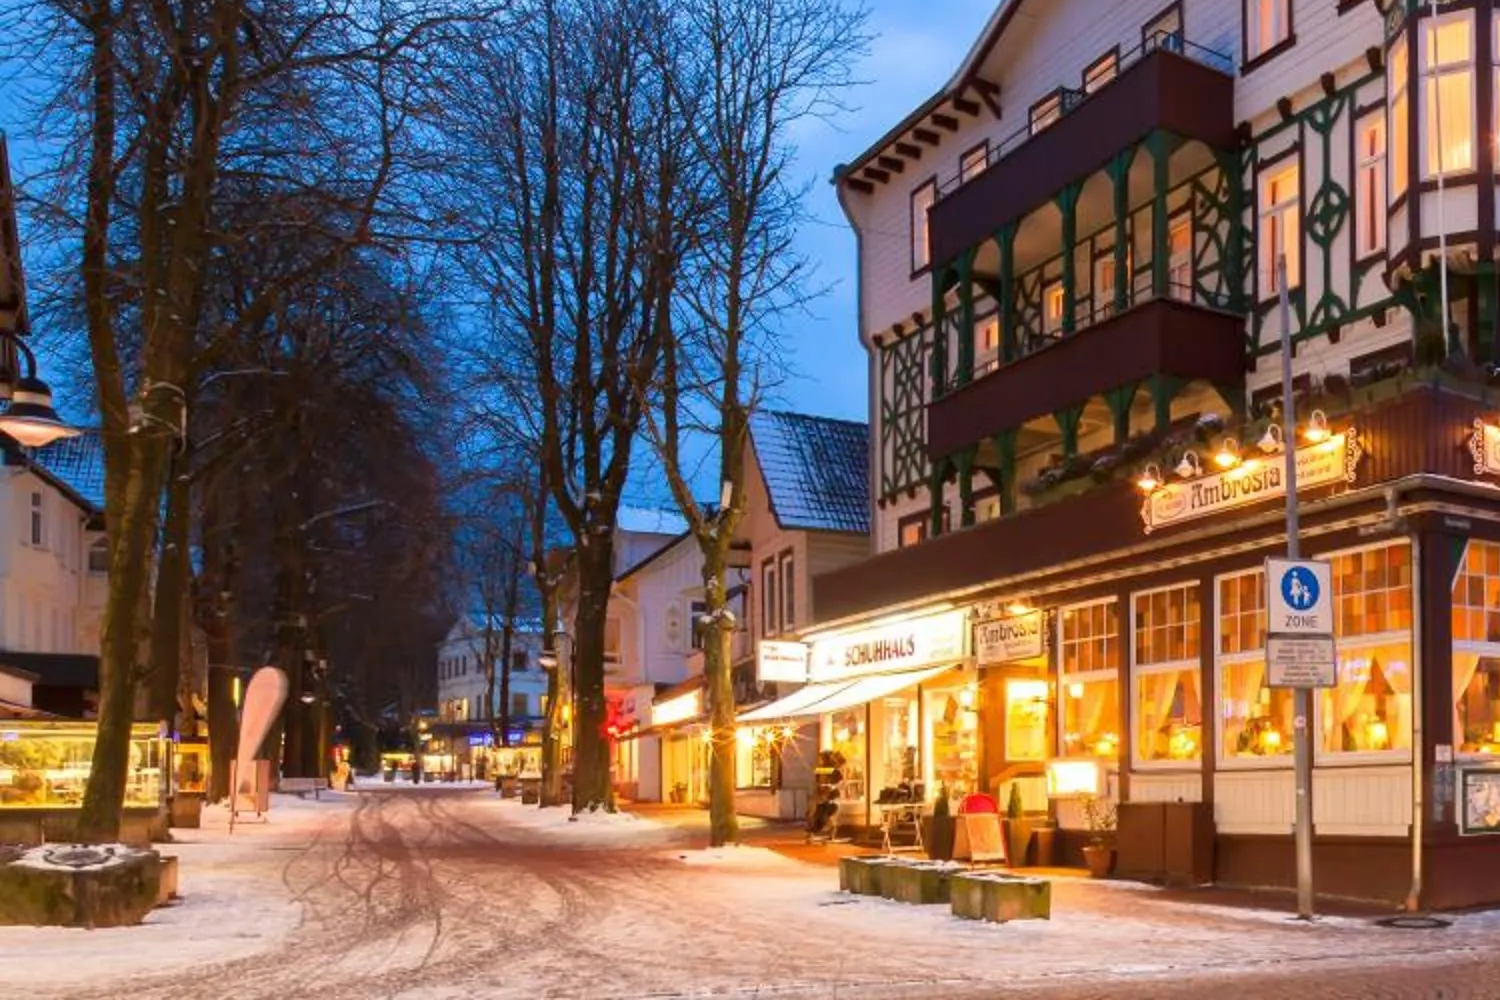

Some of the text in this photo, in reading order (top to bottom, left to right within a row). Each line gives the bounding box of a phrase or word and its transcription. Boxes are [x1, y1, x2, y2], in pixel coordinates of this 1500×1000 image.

[1191, 465, 1281, 510] Ambrosia
[1285, 615, 1318, 628] ZONE
[844, 633, 916, 667] SCHUHHAUS
